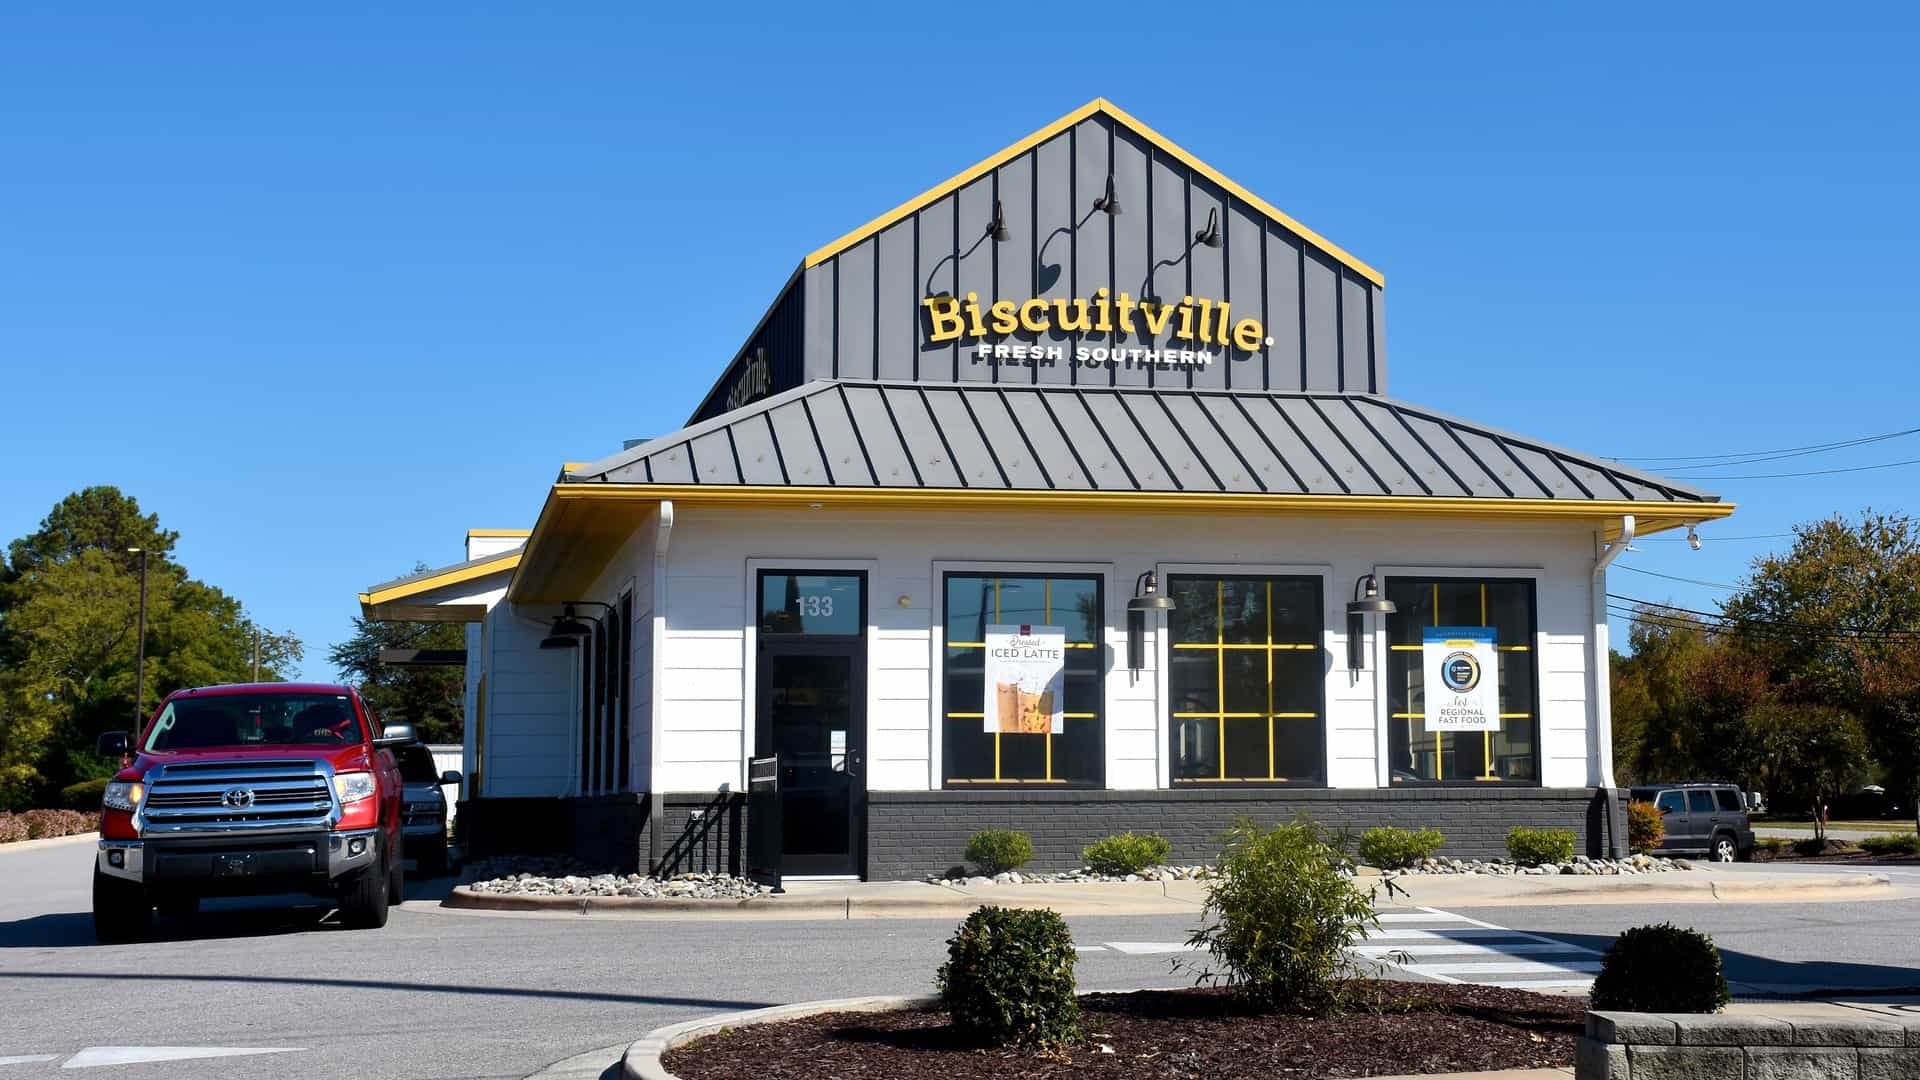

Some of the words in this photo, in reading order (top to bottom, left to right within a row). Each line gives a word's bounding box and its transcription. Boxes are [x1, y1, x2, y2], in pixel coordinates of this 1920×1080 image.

[923, 287, 1275, 353] Biscuitville.
[978, 343, 1063, 361] FRESH
[1076, 346, 1213, 365] SOUTHERN
[795, 595, 833, 617] 133
[991, 648, 1019, 658] ICED
[1024, 648, 1060, 660] LATTE
[1438, 716, 1458, 724] FAST
[1461, 716, 1487, 724] FOOD
[1440, 708, 1485, 716] REGIONAL
